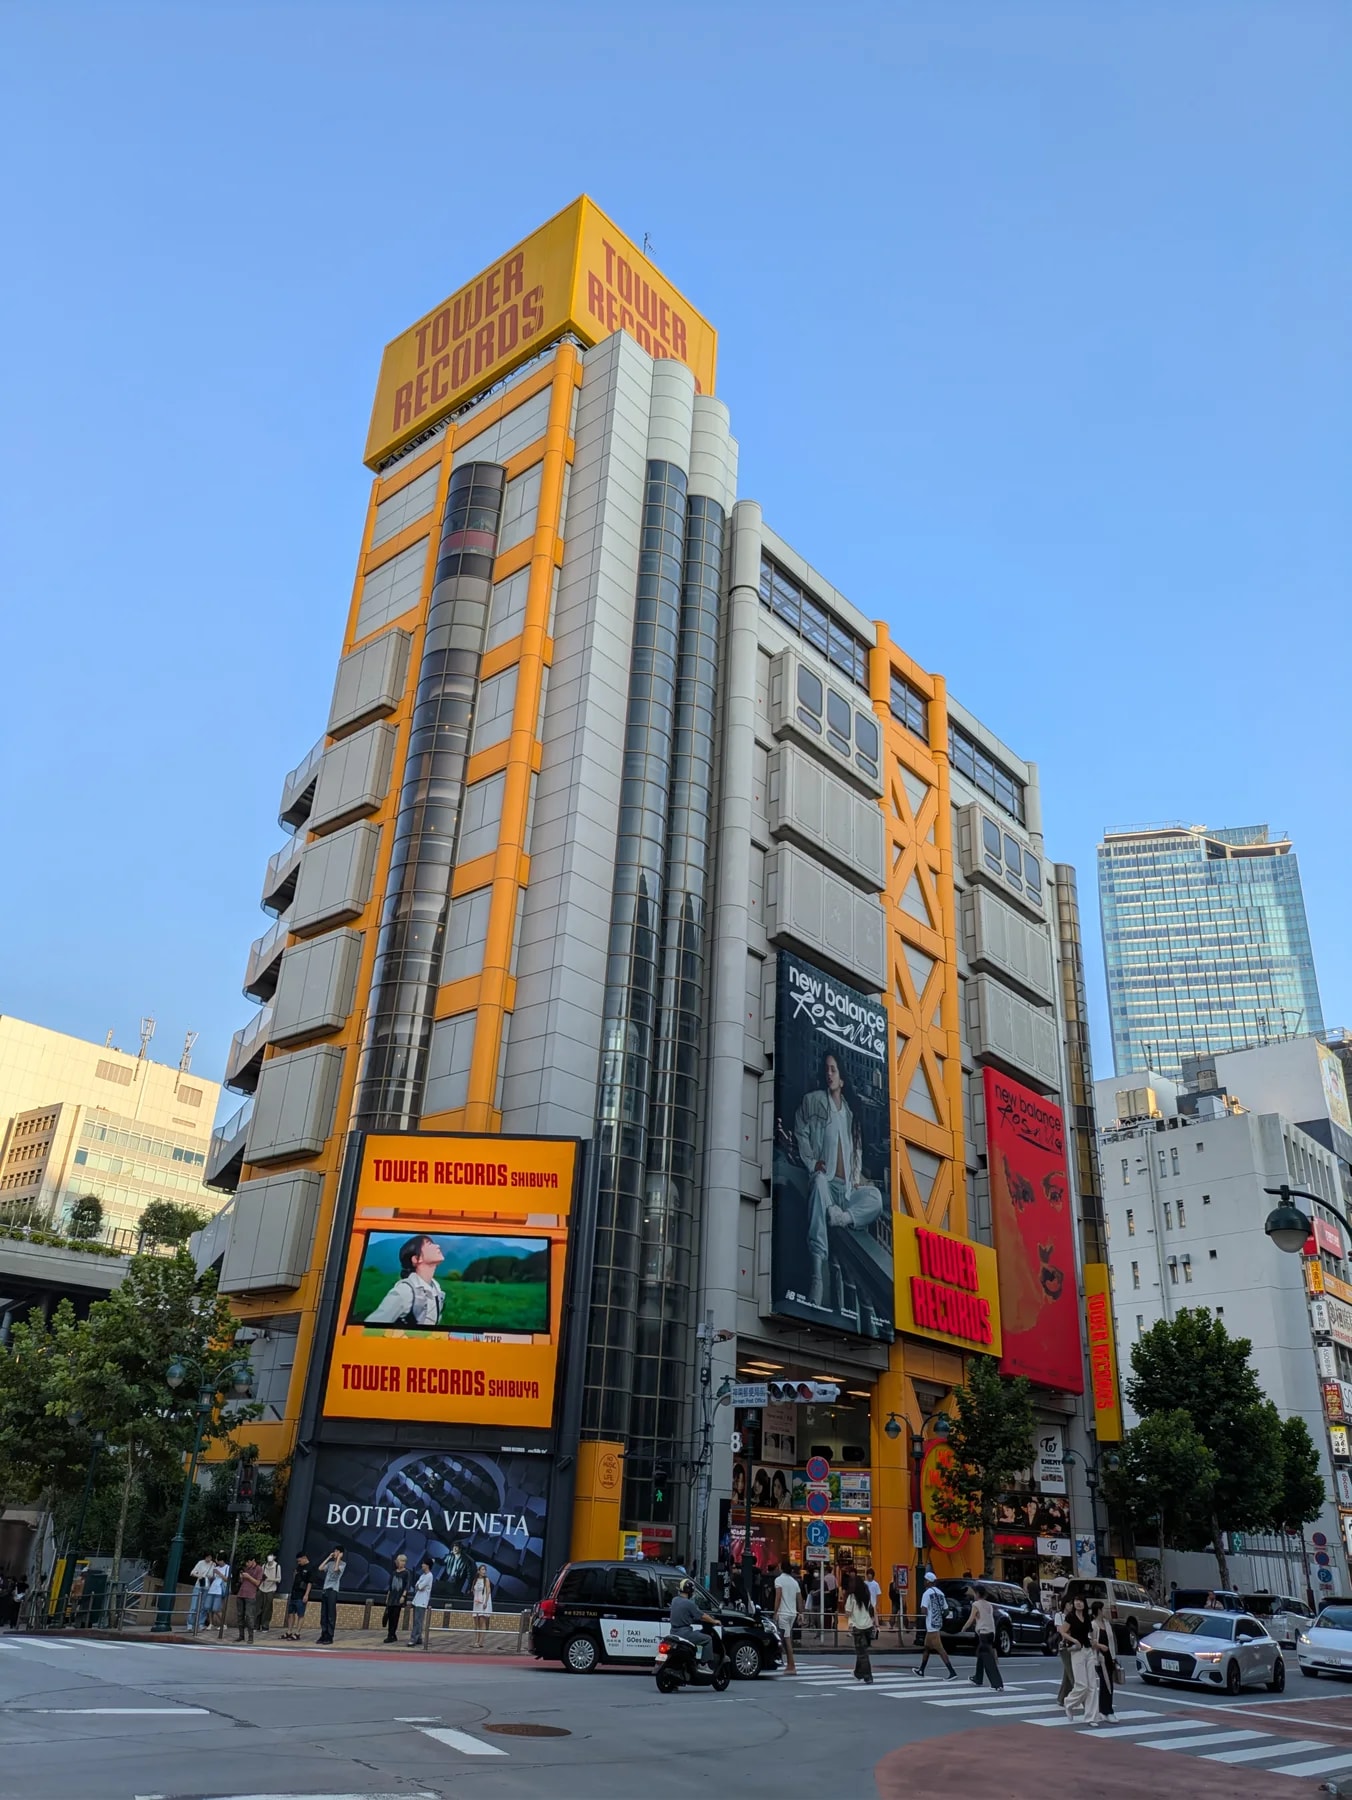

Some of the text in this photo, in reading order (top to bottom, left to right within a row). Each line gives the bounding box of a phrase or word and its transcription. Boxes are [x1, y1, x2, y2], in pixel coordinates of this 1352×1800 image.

[415, 251, 524, 369] TOWER
[602, 237, 687, 362] TOWER
[392, 284, 544, 433] RECORDS
[790, 966, 885, 1032] new balance
[996, 1085, 1061, 1131] new balance
[373, 1159, 558, 1188] TOWER RECORDS SHIBUYA
[915, 1227, 978, 1291] TOWER
[910, 1276, 993, 1345] RECORDS
[342, 1364, 539, 1399] TOWER RECORDS SHIBUYA
[1088, 1292, 1114, 1411] TOWER RECORDS
[327, 1503, 529, 1537] BOTTEGA VENETA
[812, 1527, 820, 1542] P
